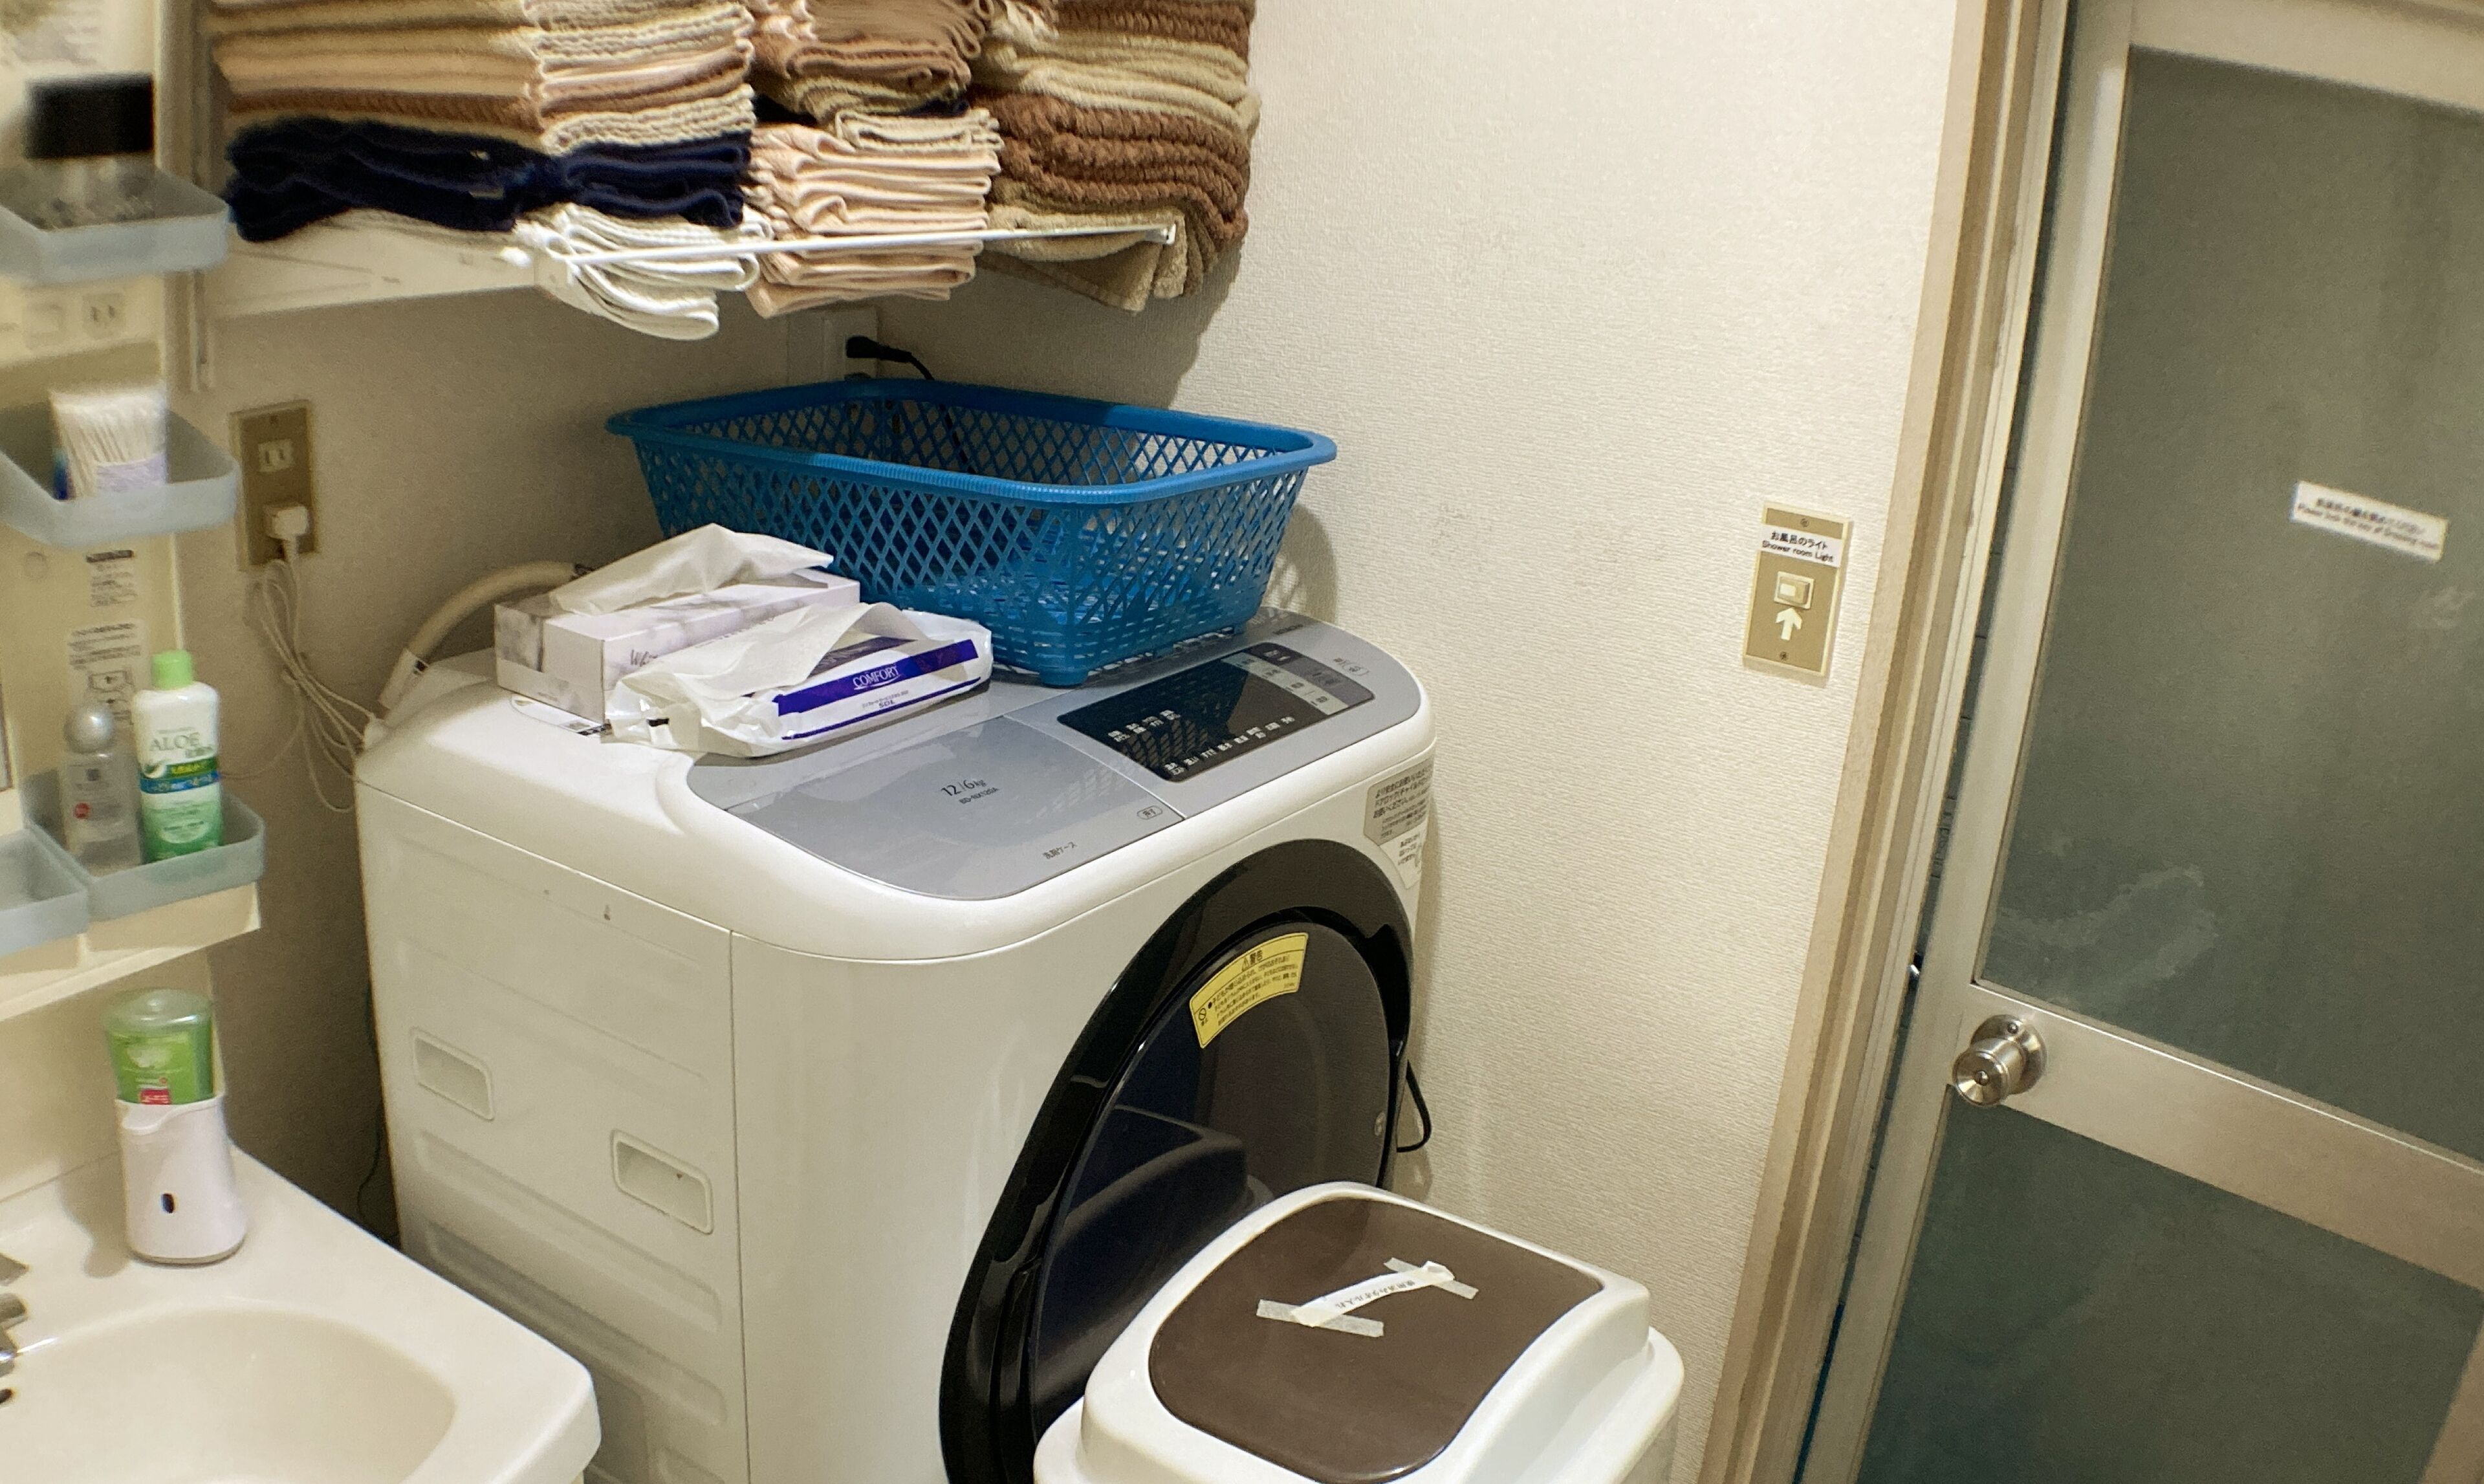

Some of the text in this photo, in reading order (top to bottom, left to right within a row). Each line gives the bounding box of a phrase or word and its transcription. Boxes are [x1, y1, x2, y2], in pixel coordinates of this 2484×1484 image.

[1762, 540, 1791, 551] Shower
[1792, 548, 1813, 557] room
[1771, 532, 1827, 549] お風呂のライト
[853, 666, 899, 688] COMFORT
[149, 732, 201, 751] ALOE
